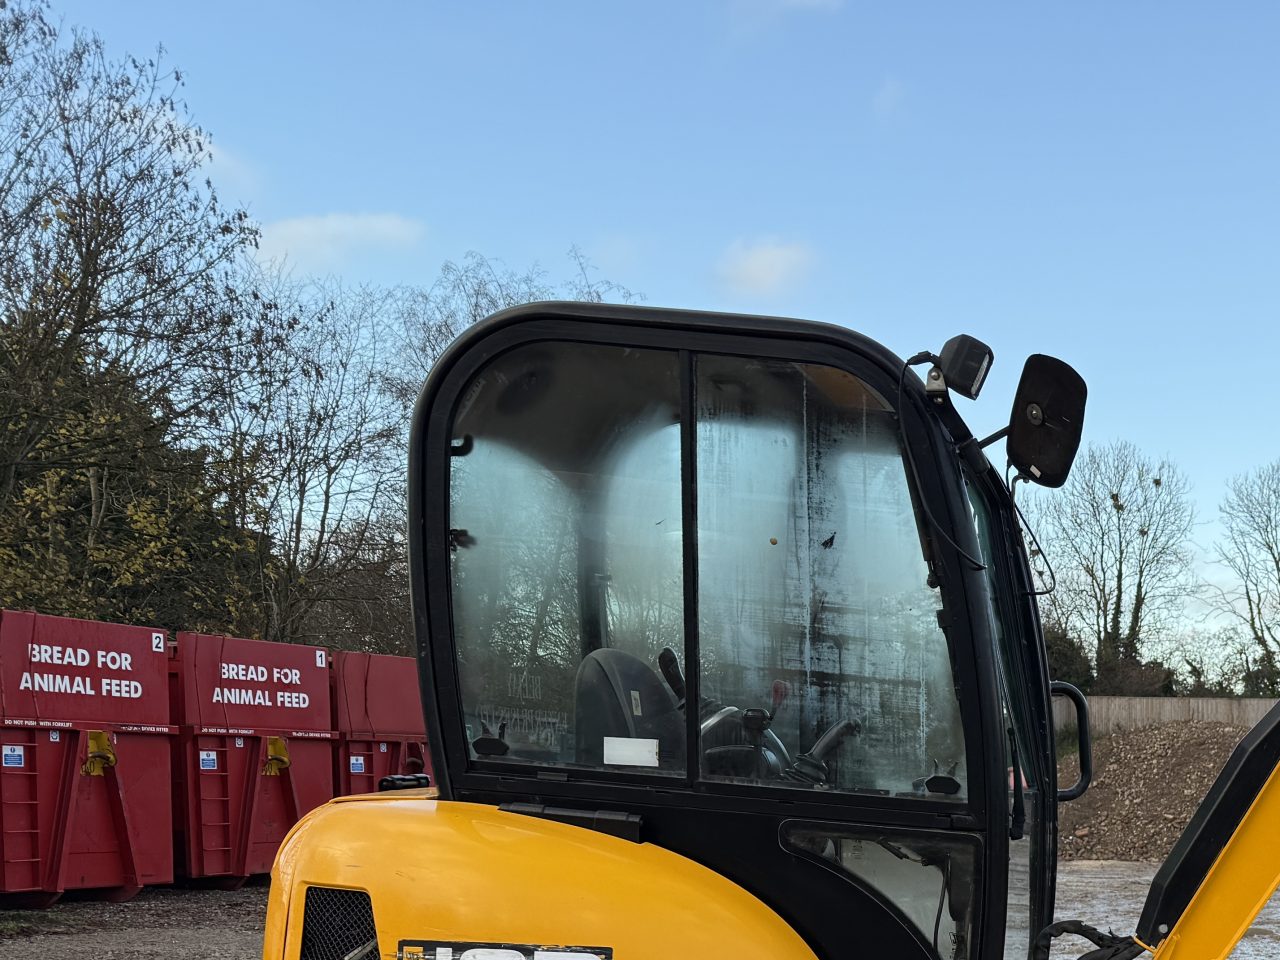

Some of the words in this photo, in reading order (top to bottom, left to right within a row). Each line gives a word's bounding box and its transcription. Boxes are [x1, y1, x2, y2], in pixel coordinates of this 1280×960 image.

[155, 635, 162, 649] 2
[28, 643, 91, 667] BREAD
[97, 650, 132, 671] FOR
[318, 653, 324, 666] 1
[220, 662, 268, 682] BREAD
[273, 668, 301, 684] FOR
[19, 672, 95, 695] ANIMAL
[101, 678, 143, 698] FEED
[212, 687, 272, 707] ANIMAL
[277, 691, 310, 708] FEED
